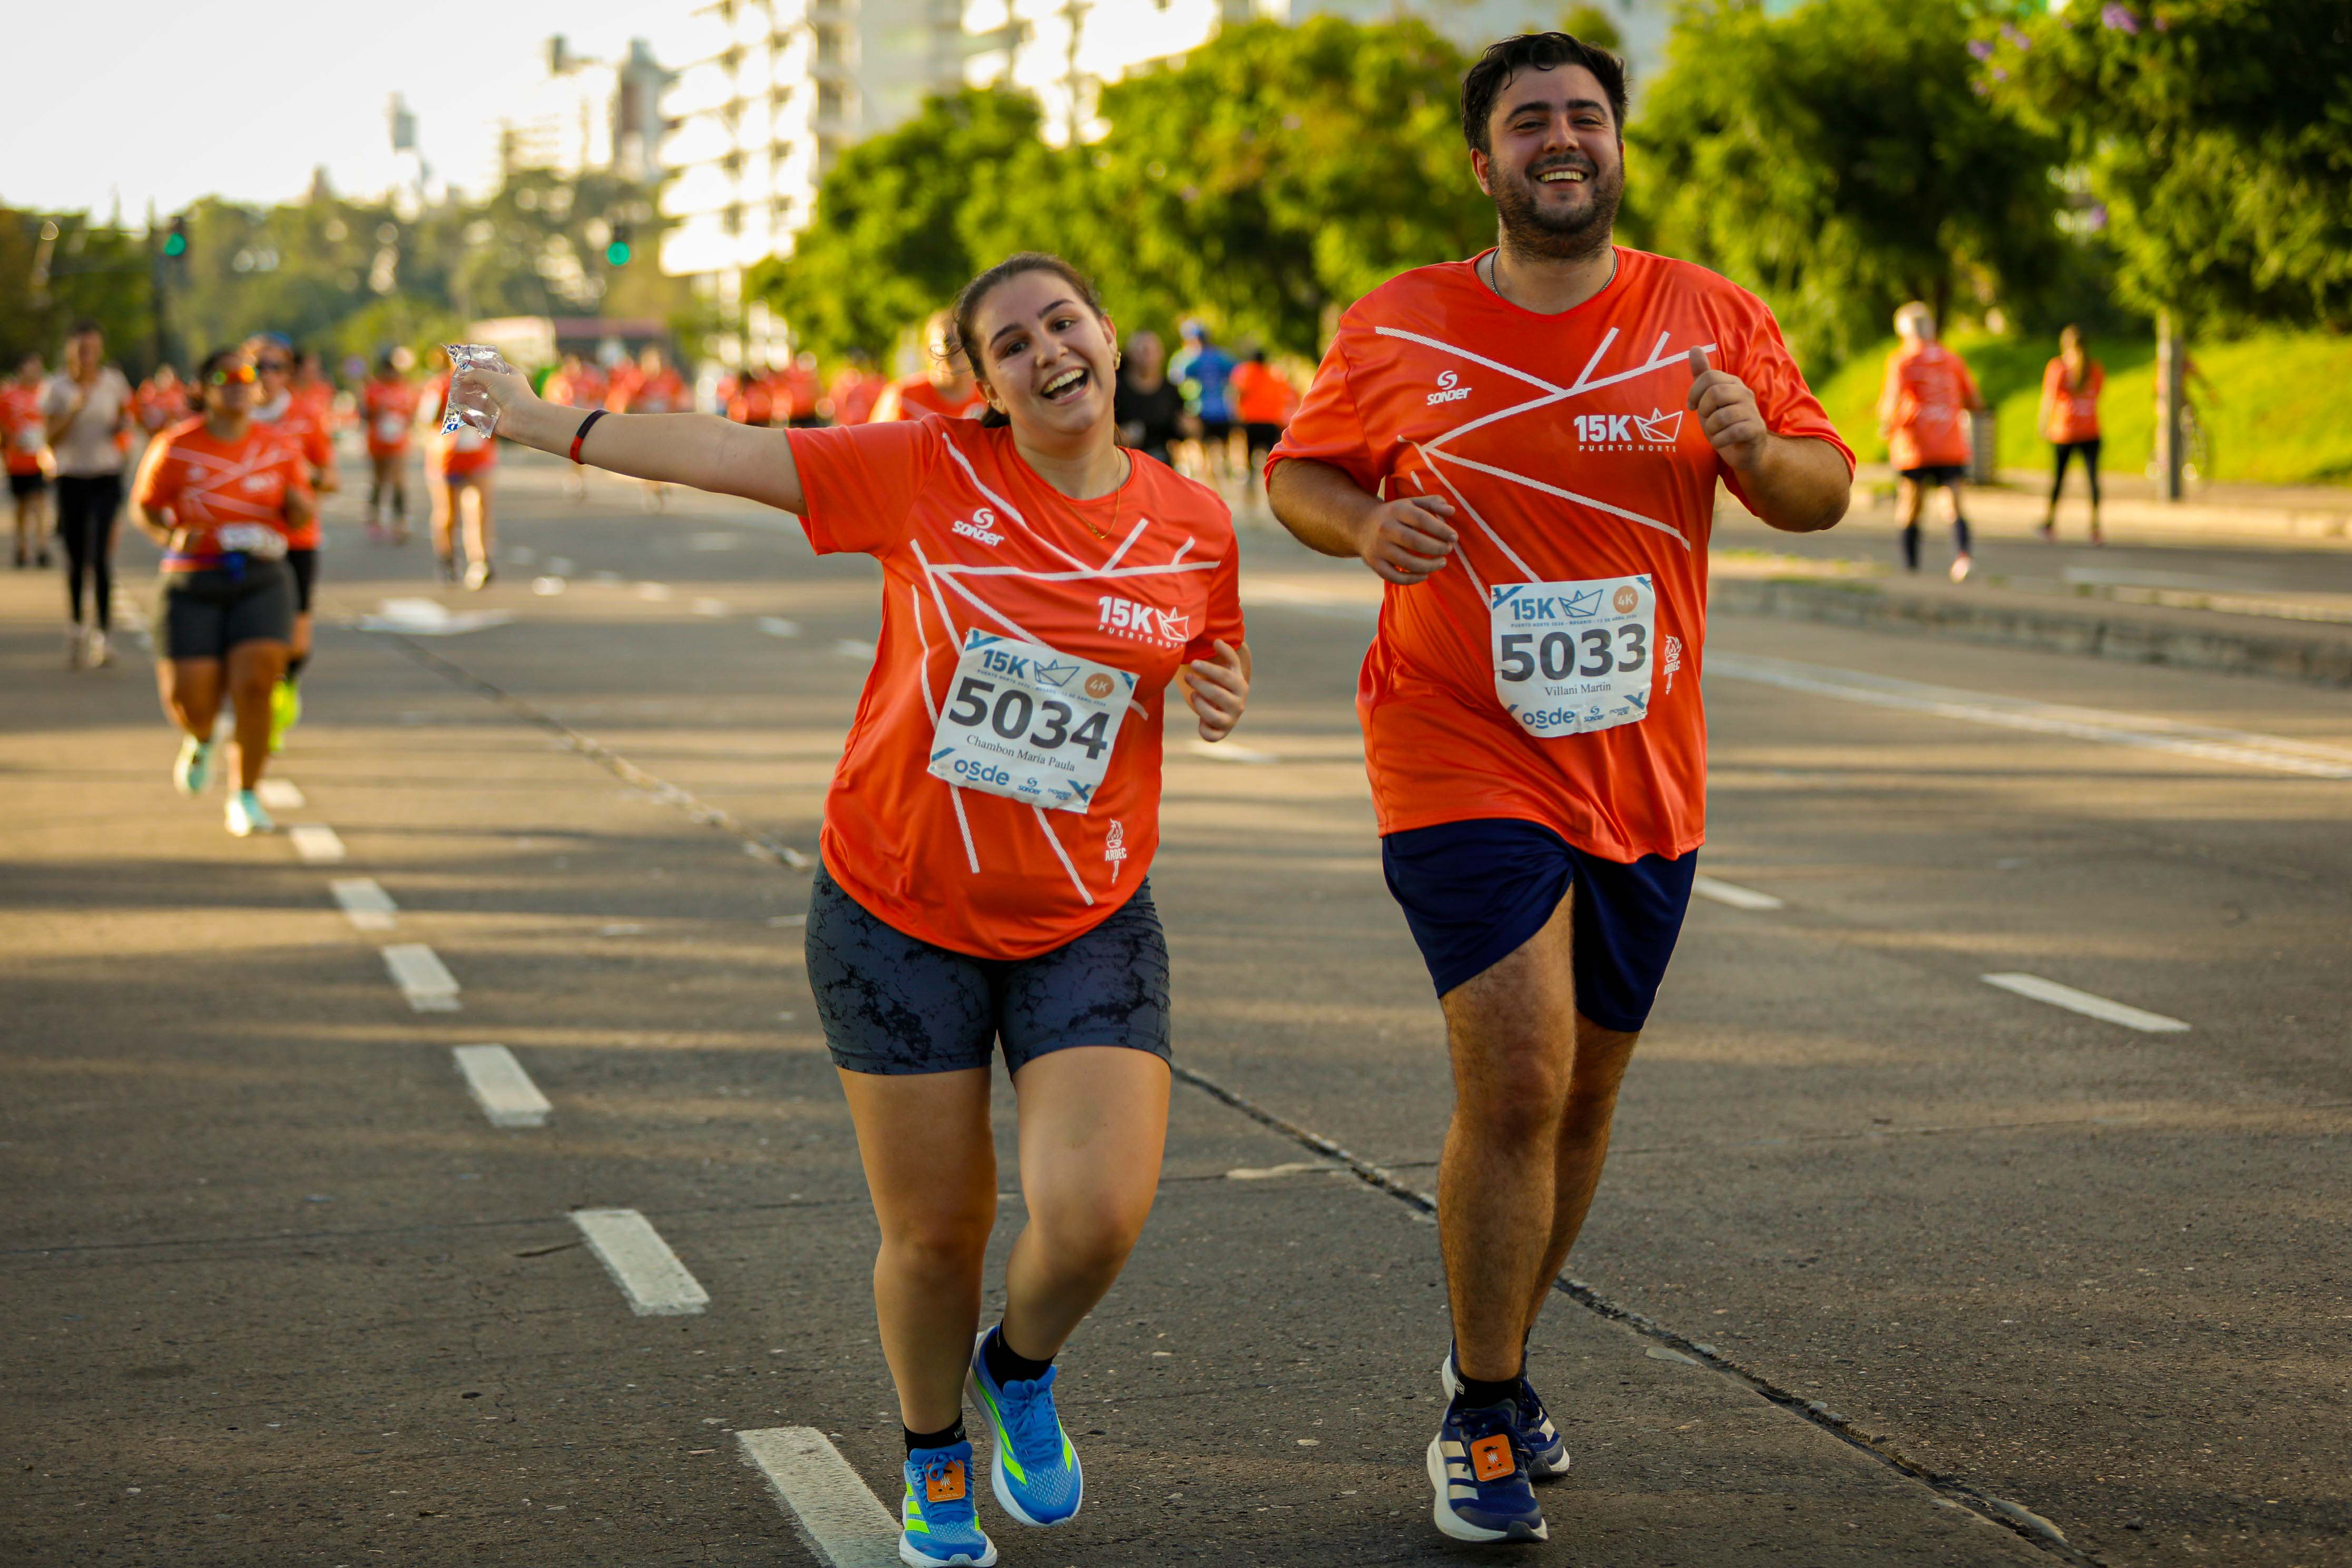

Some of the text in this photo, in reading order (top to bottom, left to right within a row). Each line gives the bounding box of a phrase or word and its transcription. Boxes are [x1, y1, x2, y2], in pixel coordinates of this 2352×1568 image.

[1573, 415, 1632, 442] 15K
[1510, 597, 1556, 621] 15K
[1618, 593, 1633, 606] 4K
[1099, 595, 1154, 634] 15K
[1098, 624, 1184, 649] PUERTO NOR
[983, 648, 1030, 679] 15K
[1501, 623, 1646, 682] 5033
[1090, 679, 1110, 693] 4K
[1544, 684, 1577, 696] Villani
[948, 676, 1110, 760] 5034
[1522, 707, 1575, 729] osde
[966, 734, 1015, 757] Chambon
[1048, 756, 1075, 771] Paula
[954, 758, 1010, 786] osde
[1105, 847, 1128, 861] ARDEC
